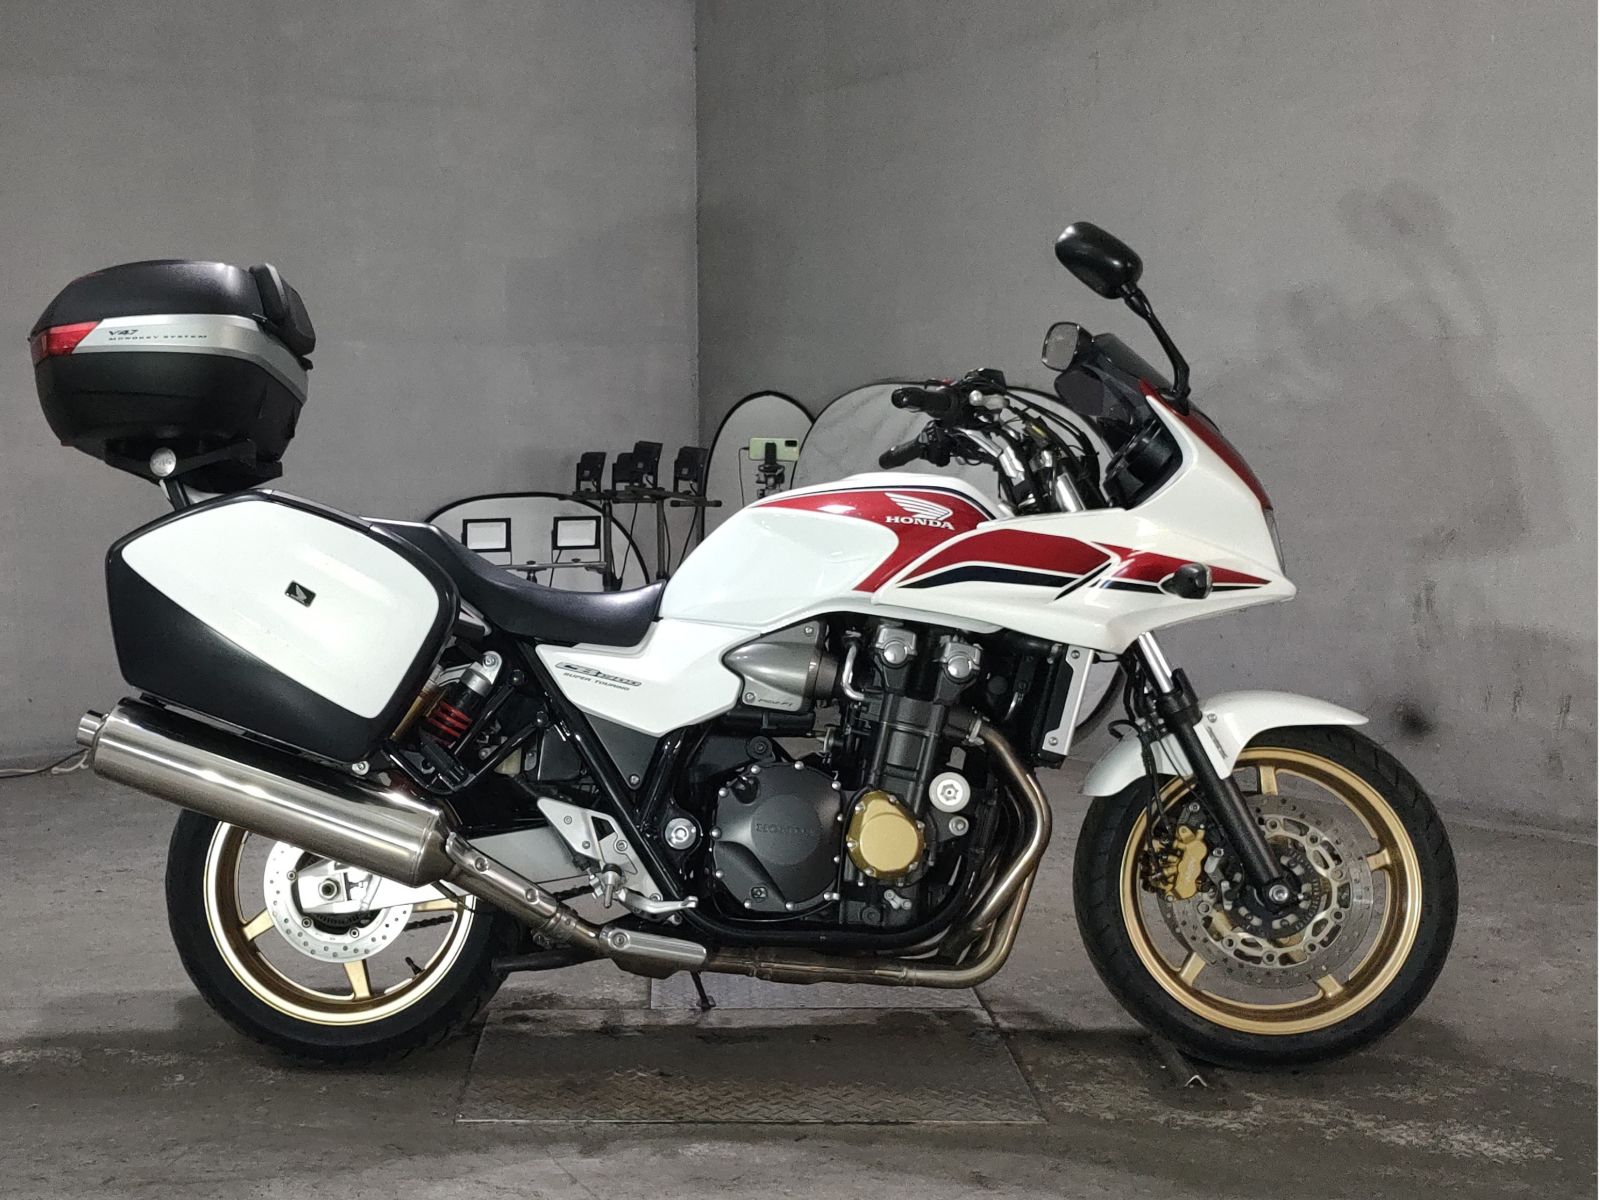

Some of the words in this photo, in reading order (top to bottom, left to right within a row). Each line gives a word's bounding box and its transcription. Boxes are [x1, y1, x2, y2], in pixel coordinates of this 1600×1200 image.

[885, 516, 955, 531] HONDA
[562, 672, 592, 682] SUPER
[594, 679, 630, 691] TOURING
